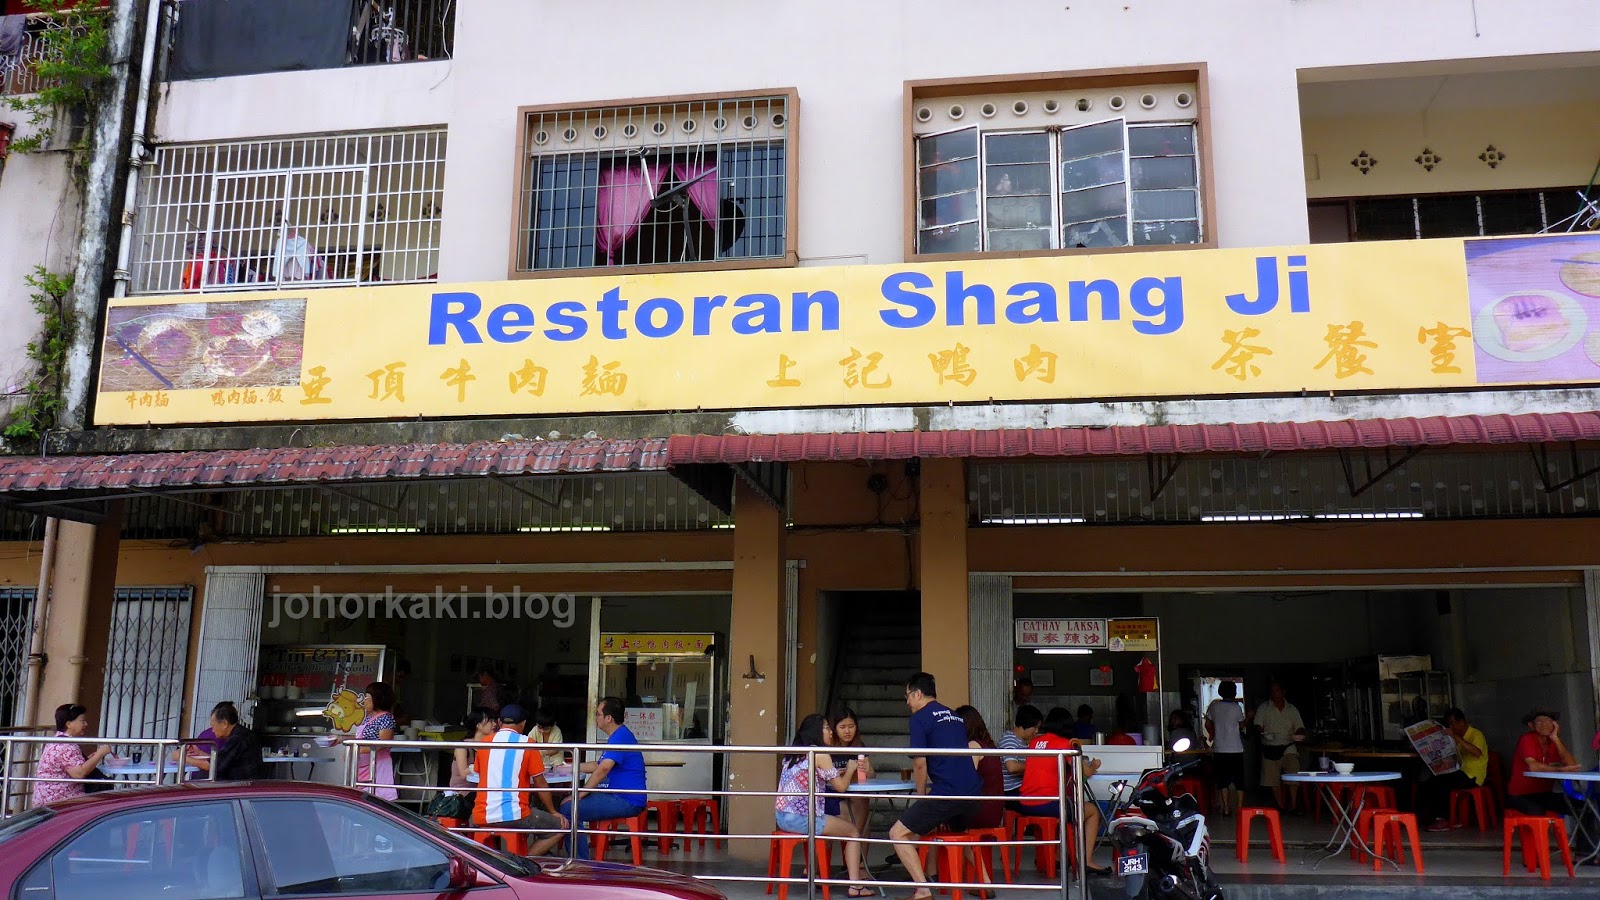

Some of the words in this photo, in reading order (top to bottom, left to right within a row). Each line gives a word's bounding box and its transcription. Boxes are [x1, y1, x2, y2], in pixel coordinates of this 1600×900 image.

[429, 288, 839, 345] Restoran
[881, 271, 1184, 335] Shang
[1226, 256, 1310, 315] Ji
[766, 342, 1062, 389] 上記鴨肉
[1211, 321, 1472, 381] 茶餐室
[125, 391, 170, 409] 牛肉麵
[1023, 621, 1060, 631] CATHAY
[1067, 621, 1100, 631] LAKSA
[1022, 632, 1100, 644] 國泰辣沙
[312, 648, 327, 663] &
[335, 649, 364, 663] Tin
[338, 663, 374, 673] Noodle
[1124, 857, 1141, 866] JRH
[1123, 864, 1143, 873] 2143
